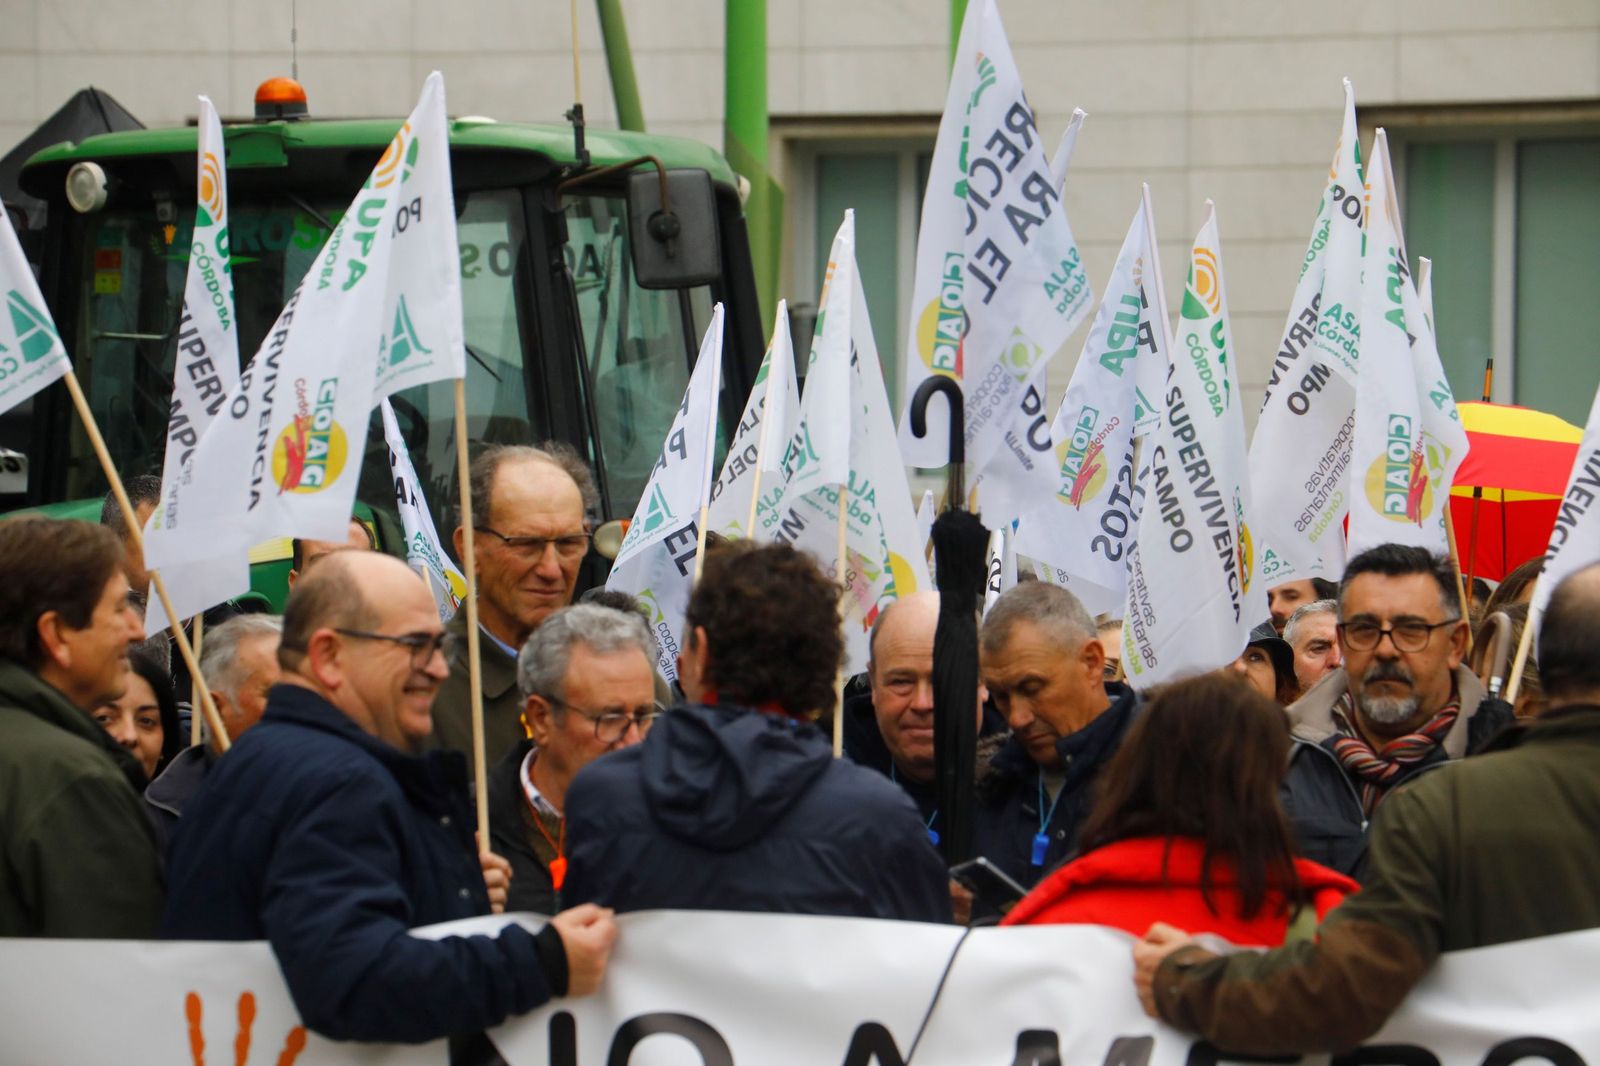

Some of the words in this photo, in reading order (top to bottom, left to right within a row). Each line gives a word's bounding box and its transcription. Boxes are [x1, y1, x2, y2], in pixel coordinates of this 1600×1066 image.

[193, 240, 231, 331] CÓRDOBA
[342, 198, 388, 291] UPA
[1185, 332, 1224, 418] CÓRDOBA
[299, 377, 339, 488] COAG
[1152, 445, 1194, 553] CAMPO
[1165, 385, 1242, 625] SUPERVIVENCIA
[663, 520, 698, 577] EL
